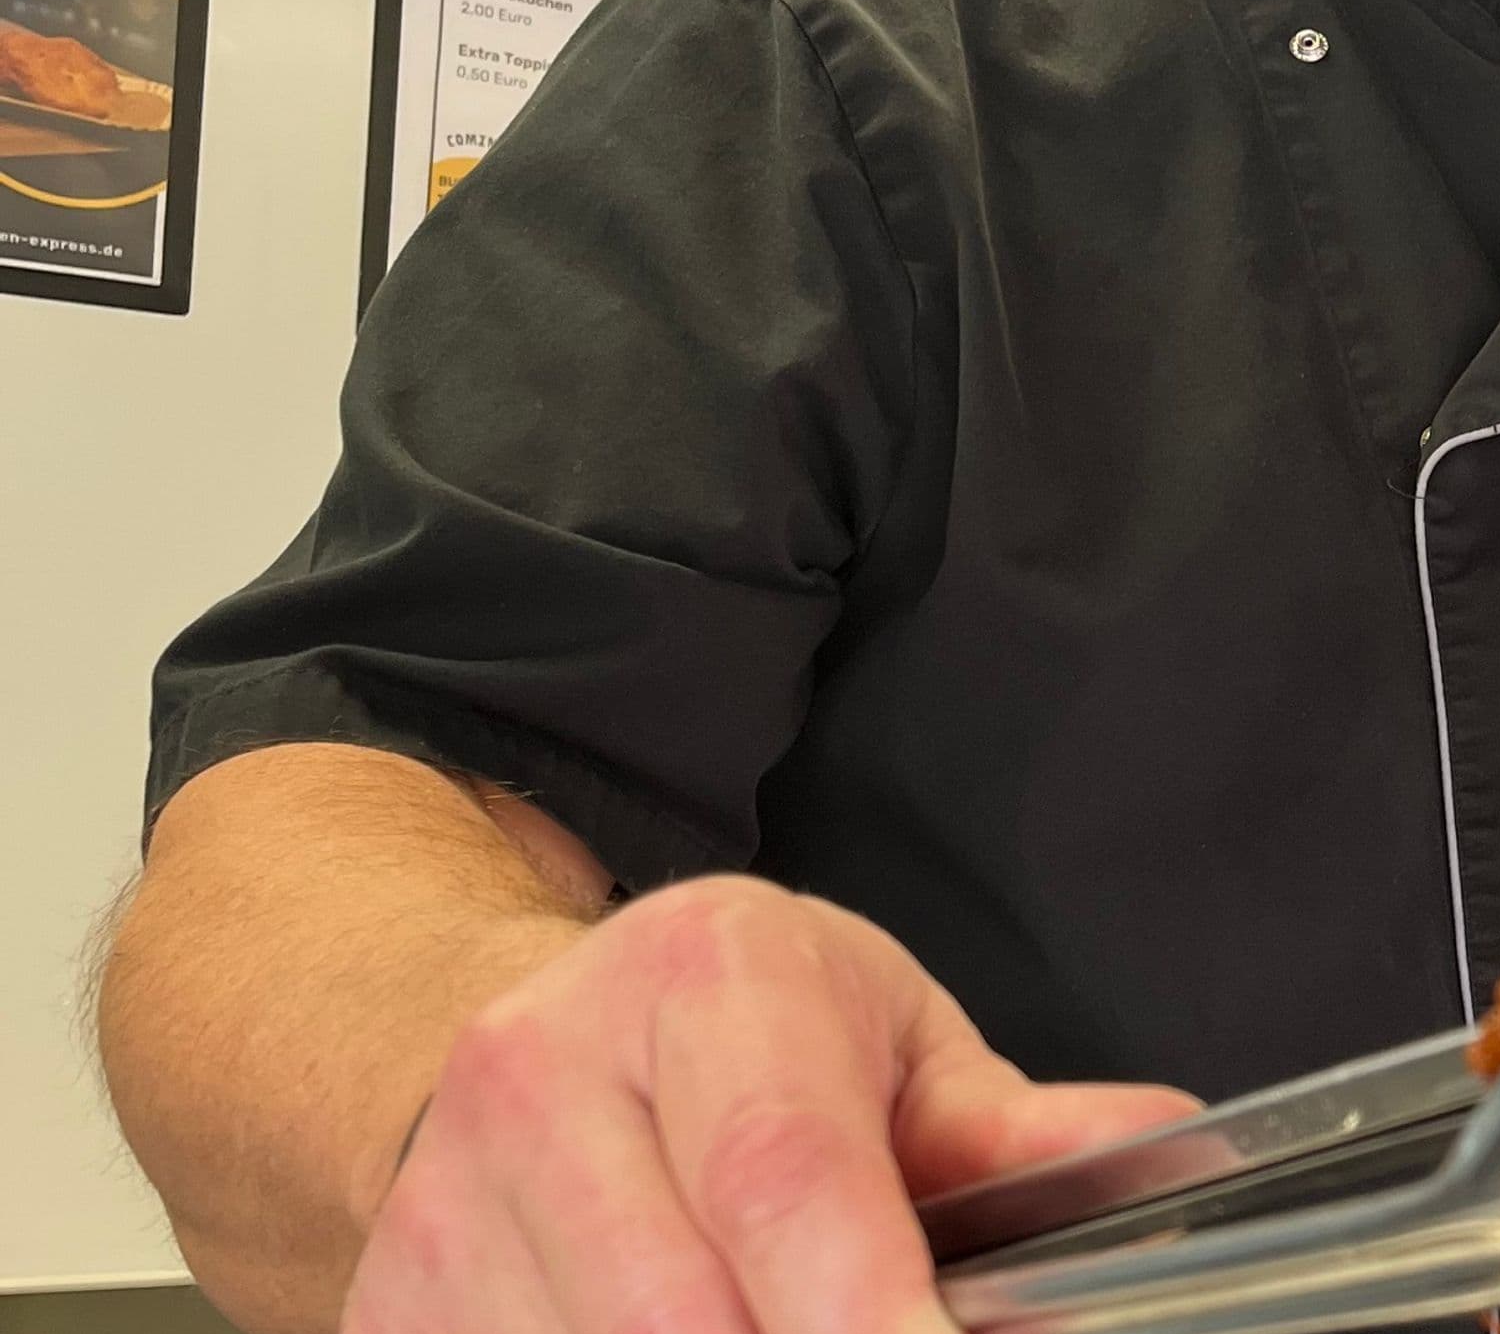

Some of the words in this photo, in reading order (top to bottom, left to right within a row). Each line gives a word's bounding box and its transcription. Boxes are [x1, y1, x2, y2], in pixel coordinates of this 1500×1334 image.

[498, 8, 532, 26] Euro
[458, 44, 500, 63] Extra
[494, 72, 528, 89] Euro
